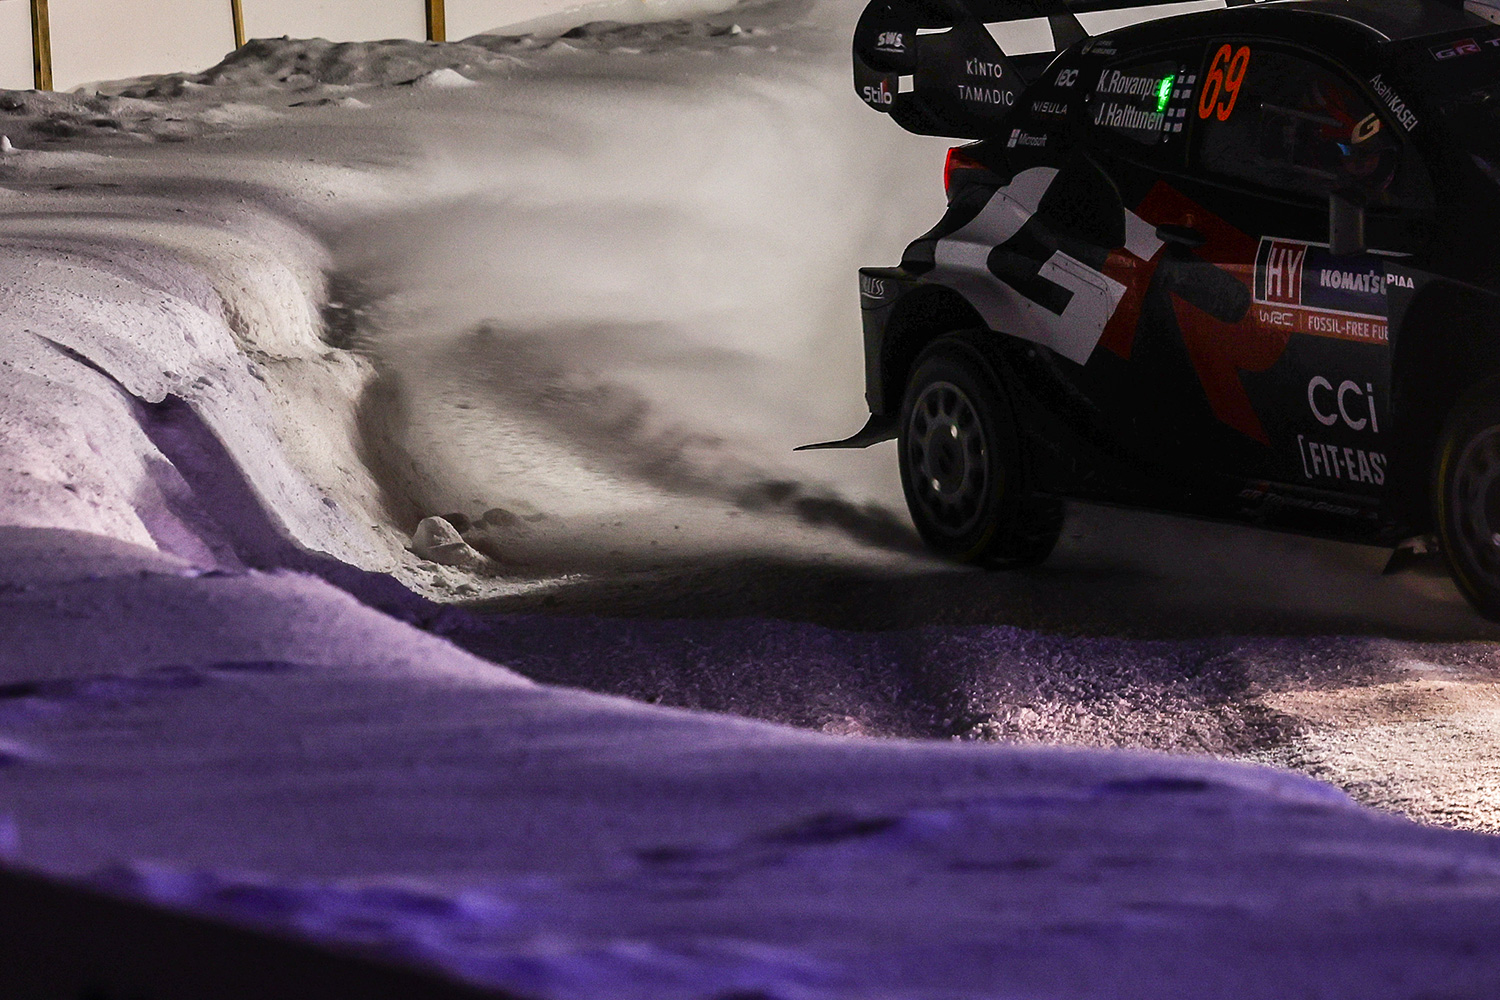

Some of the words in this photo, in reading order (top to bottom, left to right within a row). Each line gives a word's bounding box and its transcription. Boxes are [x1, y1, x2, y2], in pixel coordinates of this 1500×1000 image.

[863, 81, 893, 105] Stilo
[1198, 43, 1251, 122] 69
[957, 84, 1015, 107] TAMADIC
[1031, 100, 1069, 116] NISULA
[1267, 247, 1304, 299] HY
[1386, 272, 1416, 291] PIAA
[1259, 310, 1294, 327] WRC
[1308, 314, 1371, 338] FOSSIL-FREE
